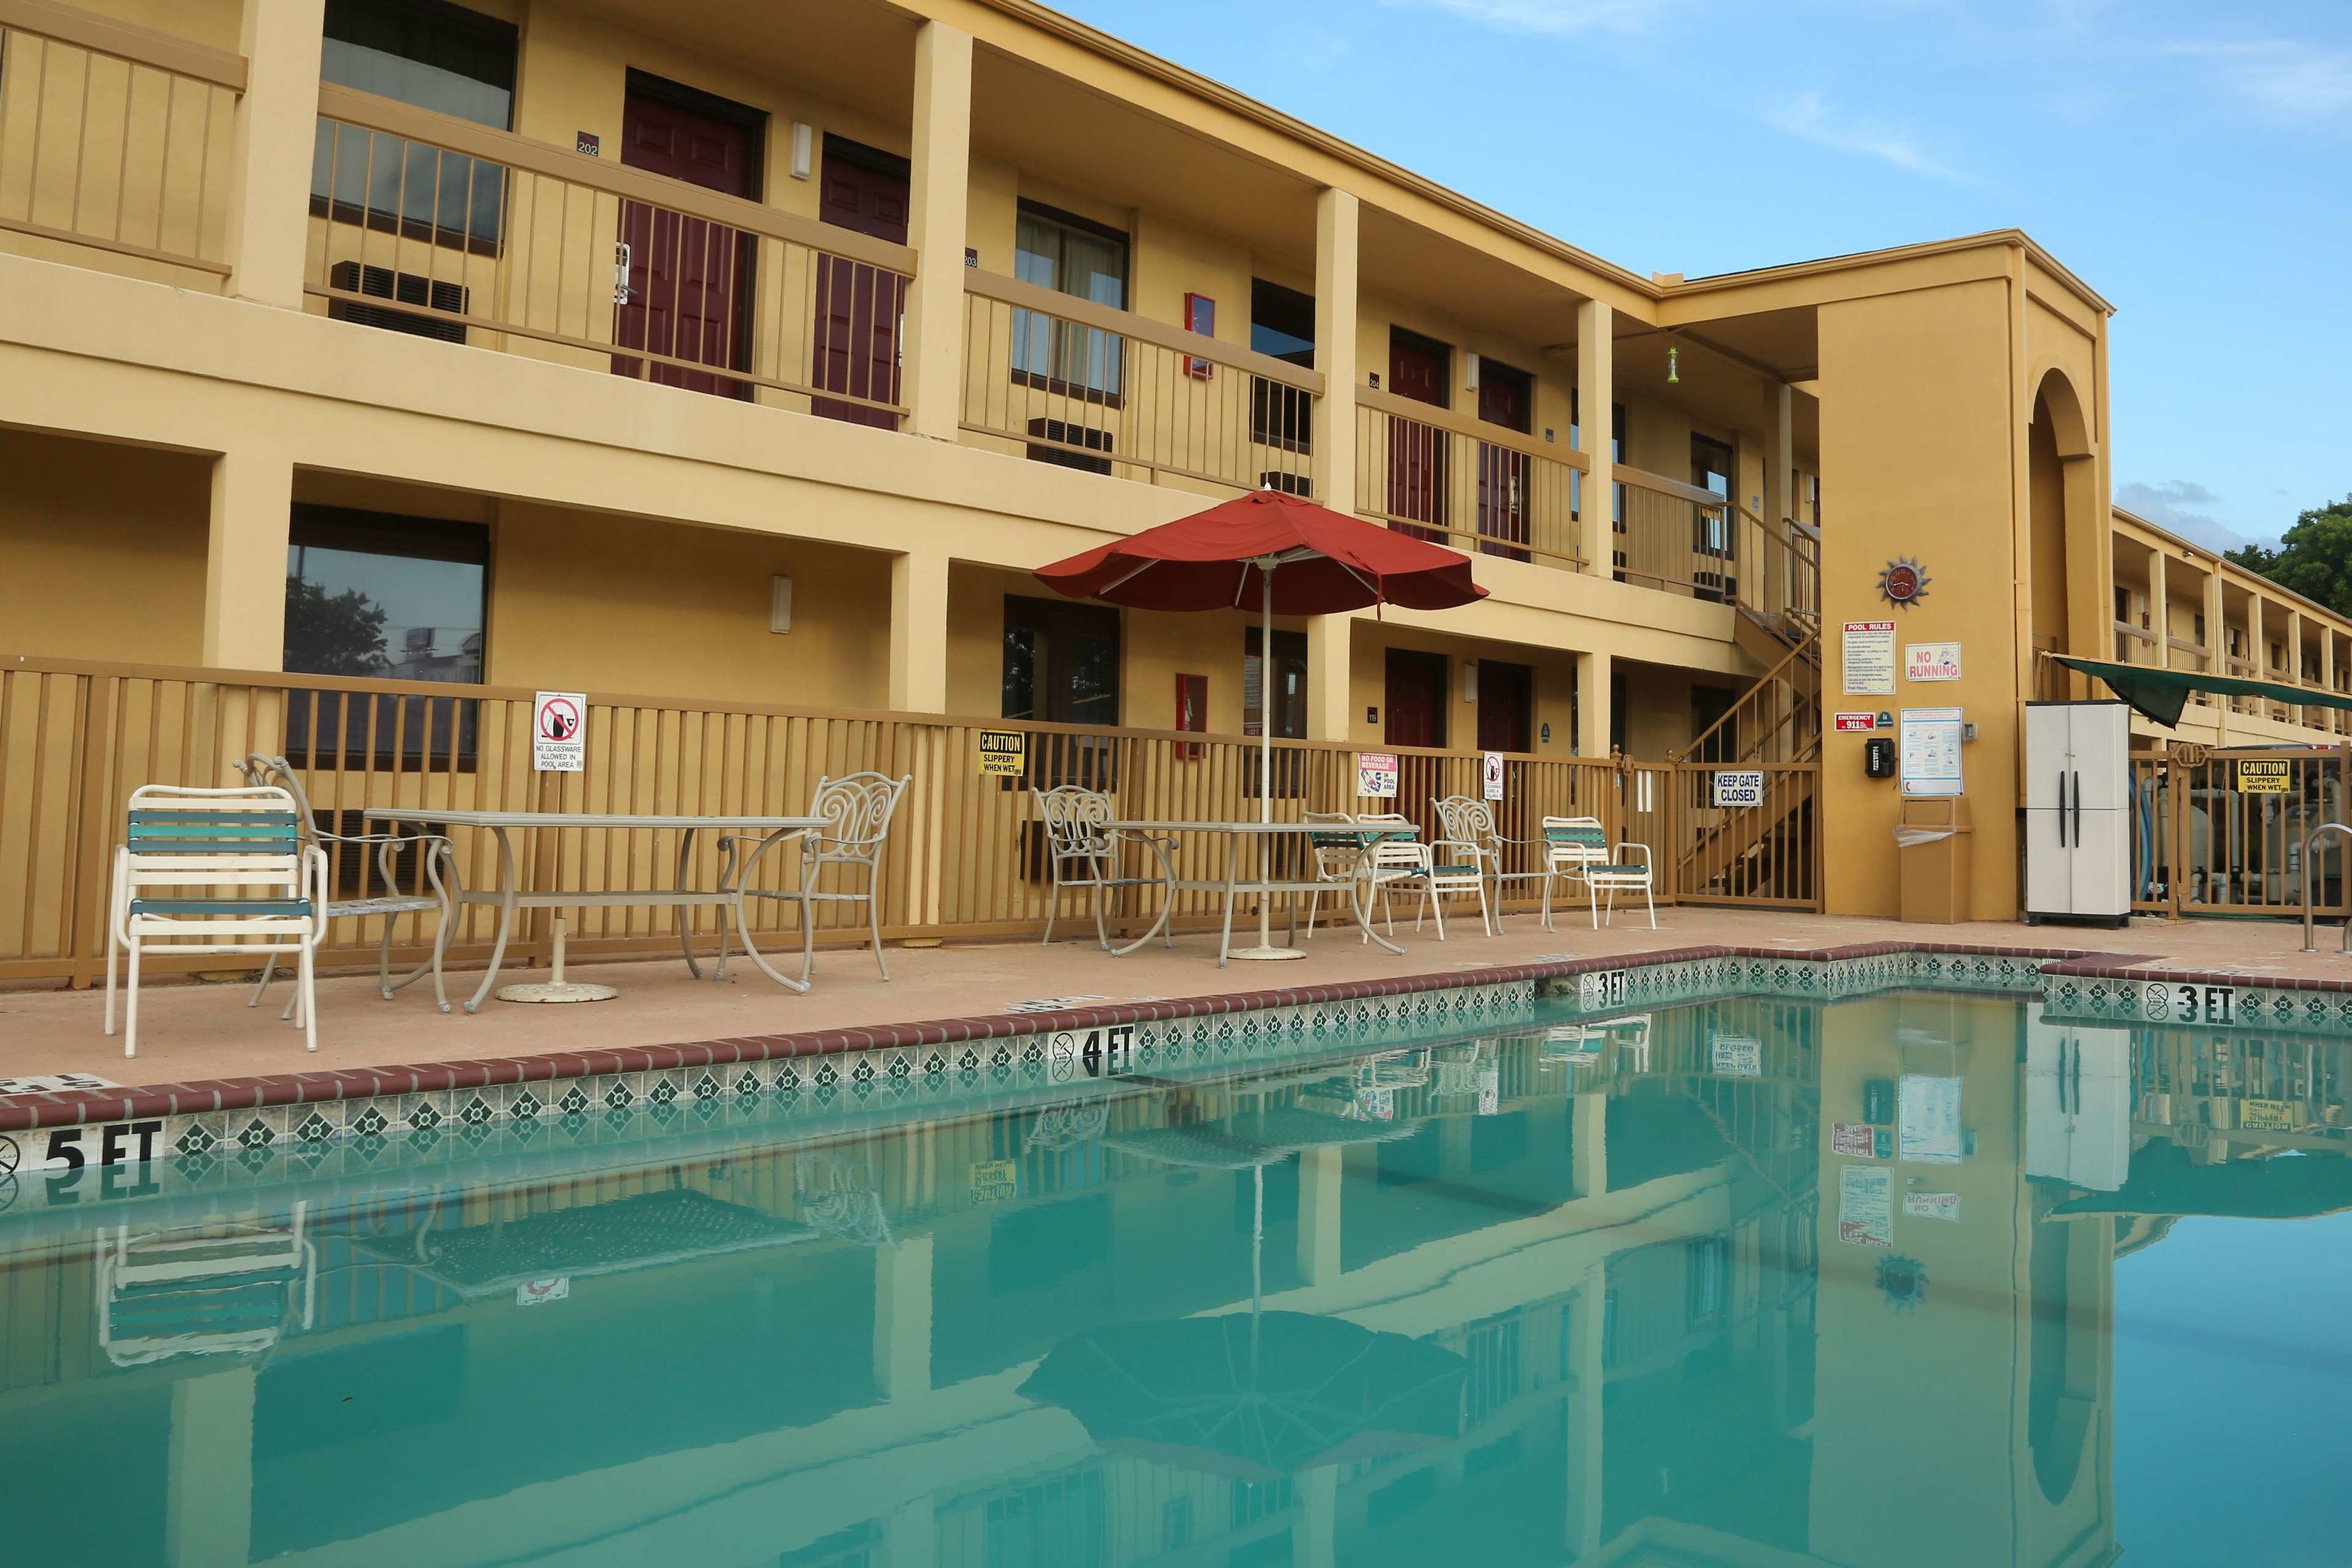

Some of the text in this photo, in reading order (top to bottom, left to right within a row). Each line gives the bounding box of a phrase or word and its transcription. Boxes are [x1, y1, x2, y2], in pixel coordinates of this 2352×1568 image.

[578, 142, 597, 156] 202
[1370, 380, 1379, 388] 204
[1916, 651, 1931, 663] NO
[1910, 664, 1958, 677] RUNNING
[981, 734, 1021, 751] CAUTION
[984, 754, 1015, 763] SLIPPERY
[2242, 762, 2285, 775] CAUTION
[1718, 775, 1760, 787] KEEP GATE
[1721, 789, 1756, 801] CLOSED
[2205, 987, 2234, 1008] FT
[1082, 1026, 1133, 1058] 4 FT
[46, 1121, 162, 1169] 5 FT
